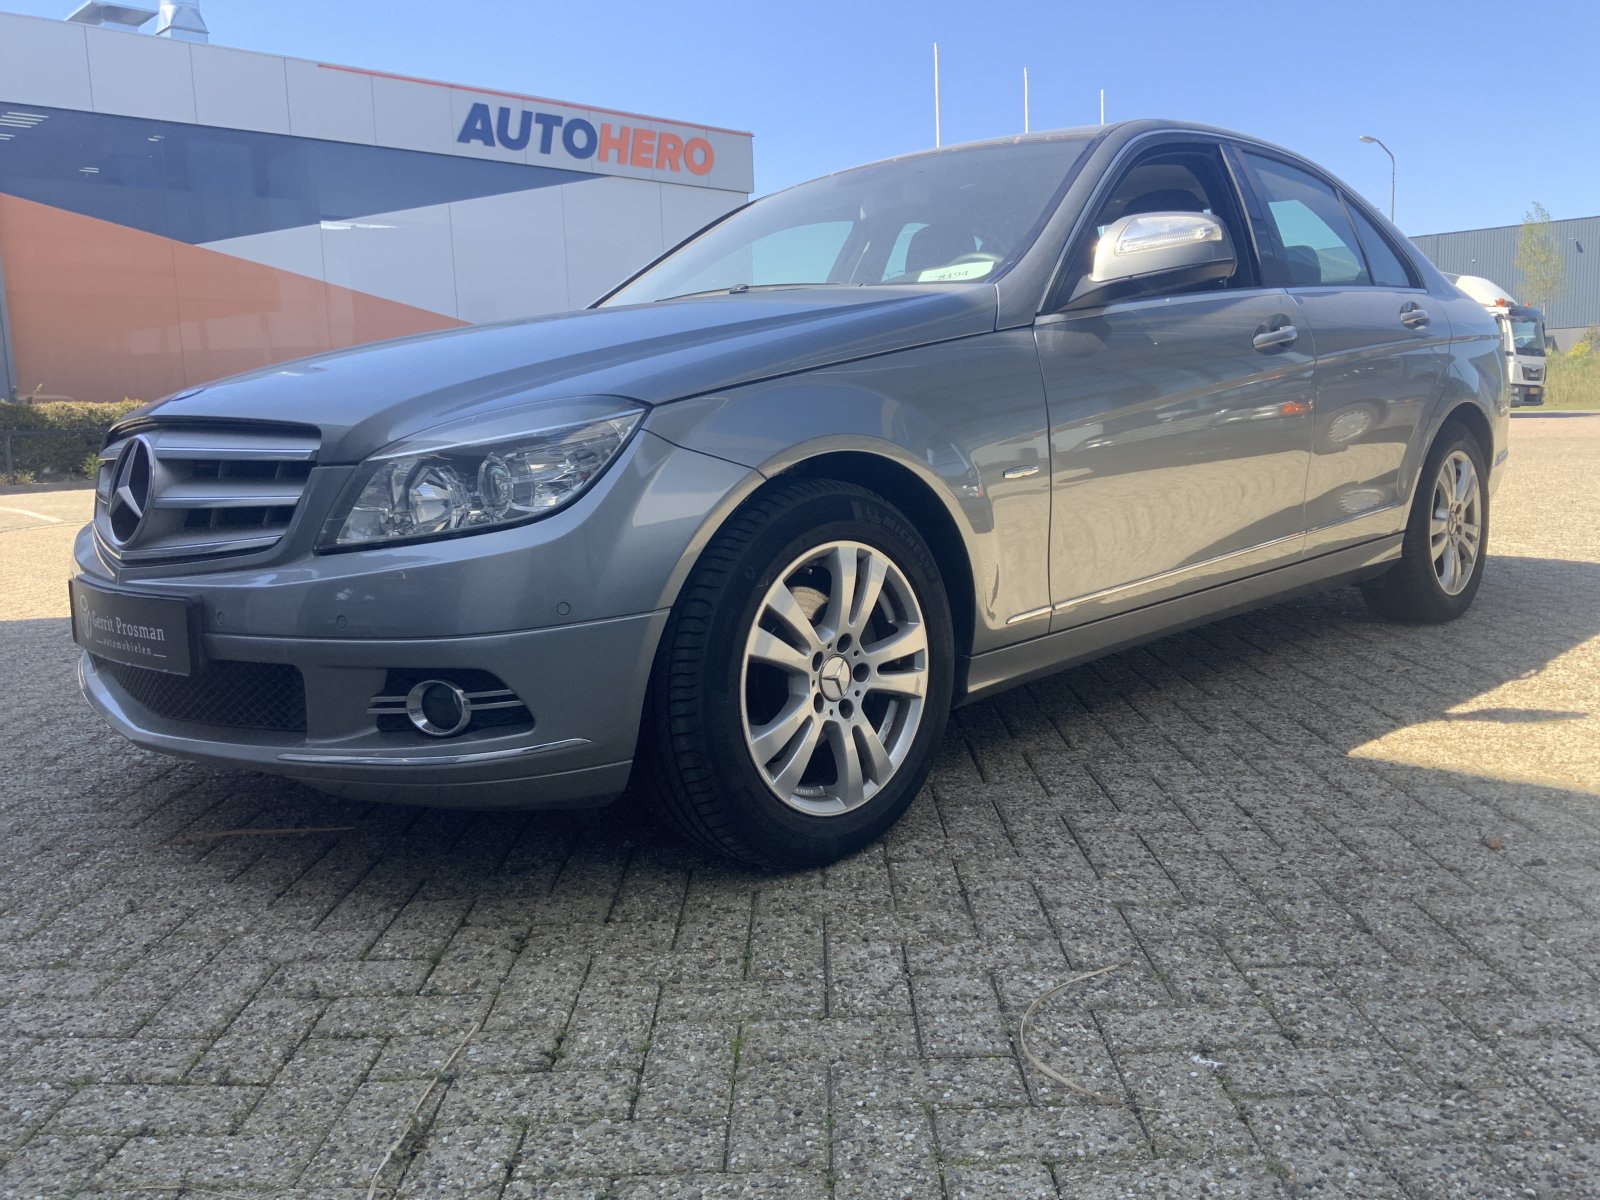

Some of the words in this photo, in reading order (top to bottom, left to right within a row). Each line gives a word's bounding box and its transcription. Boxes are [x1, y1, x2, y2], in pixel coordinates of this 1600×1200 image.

[457, 102, 714, 175] AUTOHERO
[92, 612, 114, 632] Gerrit
[116, 616, 165, 641] Prosman
[104, 638, 152, 655] automobielen
